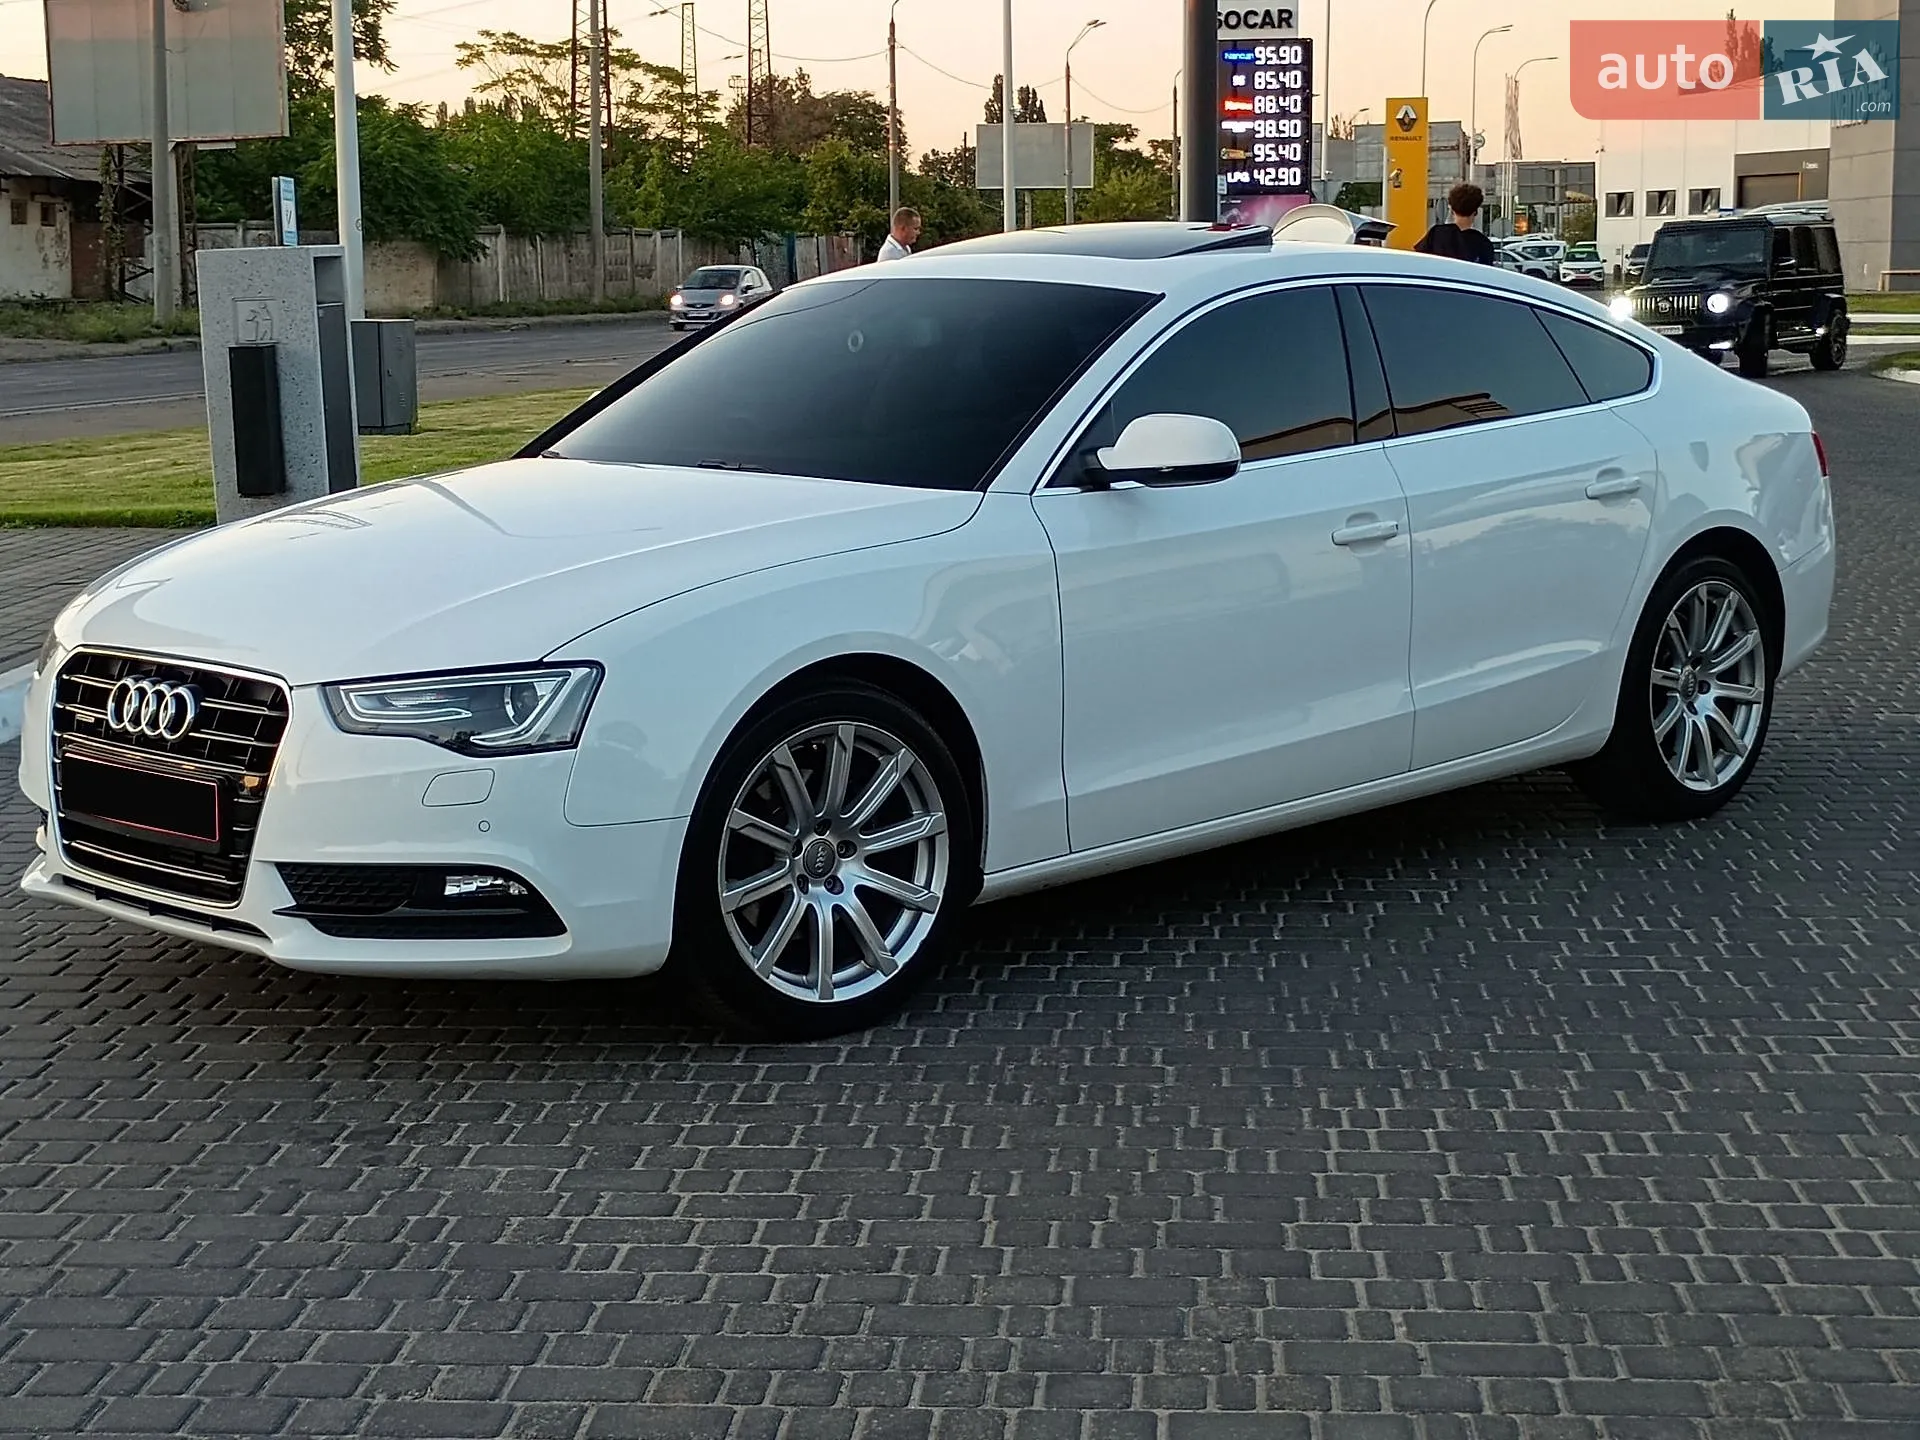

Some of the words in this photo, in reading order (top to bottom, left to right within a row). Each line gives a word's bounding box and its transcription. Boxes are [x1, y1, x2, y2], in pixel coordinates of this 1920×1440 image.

[1254, 45, 1302, 65] 95.90
[1254, 70, 1302, 90] 85.40
[1254, 119, 1301, 138] 98.90
[1253, 143, 1301, 162] 95.40
[1253, 167, 1301, 186] 42.90
